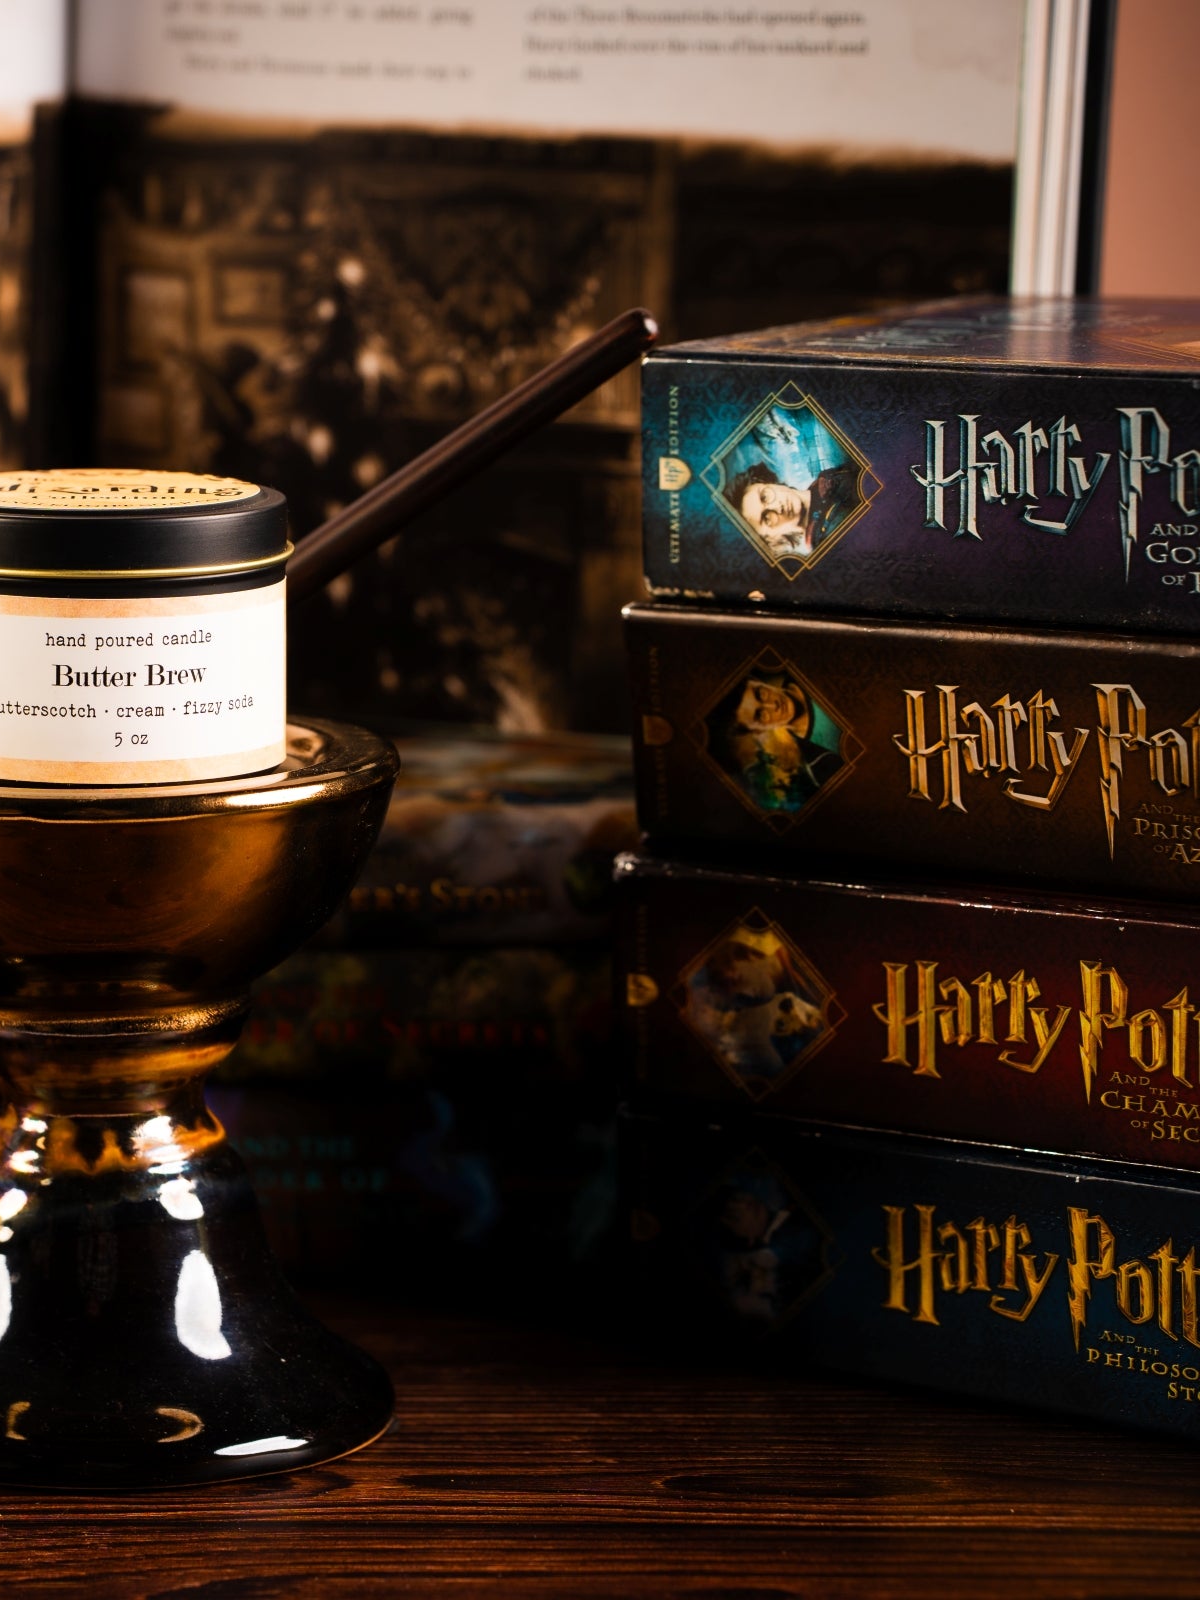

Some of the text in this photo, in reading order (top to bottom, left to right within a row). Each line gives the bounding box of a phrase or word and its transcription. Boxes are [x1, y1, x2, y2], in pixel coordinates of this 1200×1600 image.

[668, 385, 680, 456] EDITION
[909, 414, 1111, 542] Harry
[1150, 523, 1199, 536] AND
[1145, 541, 1200, 564] GO
[1161, 574, 1186, 586] OF
[45, 630, 212, 651] hand poured candle
[51, 663, 207, 688] Butter Brew
[116, 703, 165, 718] cream
[183, 698, 222, 716] fizzy
[228, 695, 254, 711] soda
[114, 732, 148, 747] 5 oz
[891, 684, 1091, 814] Harry
[872, 959, 1200, 1105] Harry Pot
[1109, 1071, 1178, 1098] AND THE
[1130, 1119, 1150, 1129] OF
[870, 1203, 1060, 1326] Harry
[1098, 1330, 1136, 1344] AND
[1167, 1381, 1200, 1402] ST
